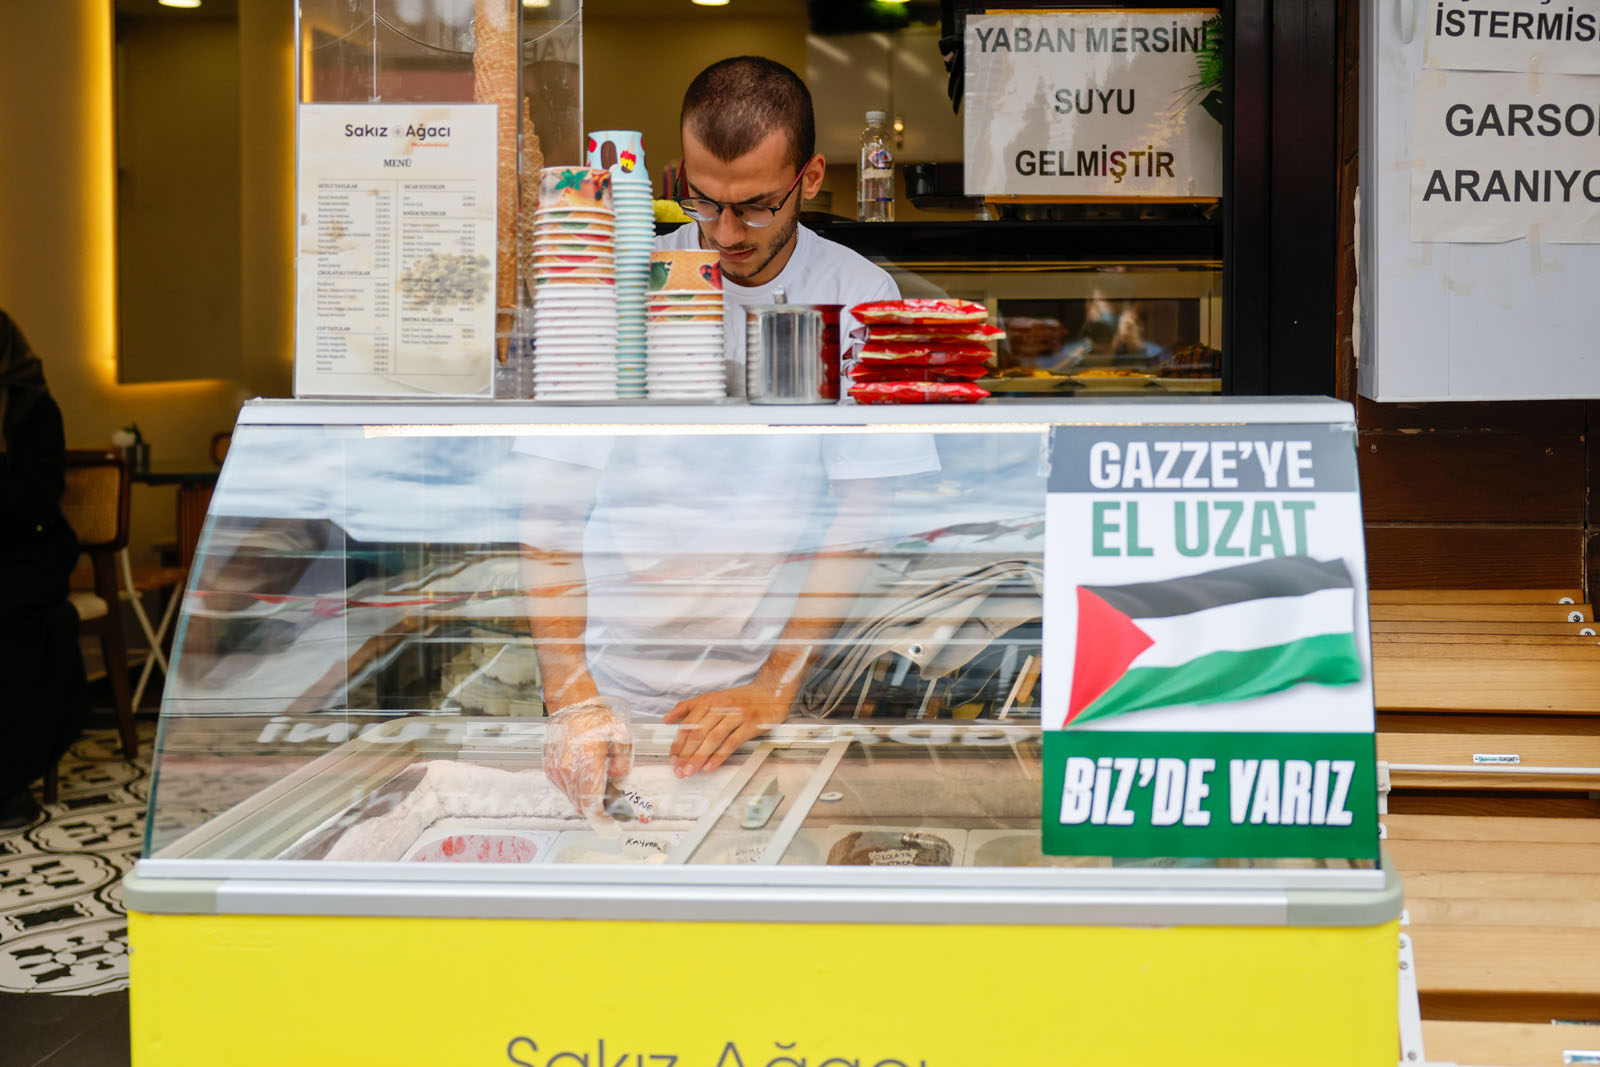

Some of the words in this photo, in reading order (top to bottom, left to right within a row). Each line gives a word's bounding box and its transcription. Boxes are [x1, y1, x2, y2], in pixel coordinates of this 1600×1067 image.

[975, 27, 1077, 53] YABAN
[1435, 2, 1600, 42] İSTERMİS
[1054, 88, 1136, 115] SUYU
[1445, 103, 1600, 137] GARSO
[344, 123, 389, 137] Sakız
[405, 123, 451, 141] Ağacı
[383, 158, 412, 168] MENÜ
[1015, 144, 1176, 184] GELMİŞTİR
[1089, 441, 1315, 489] GAZZE'YE
[1091, 500, 1154, 557] EL
[1173, 500, 1316, 558] UZAT
[1228, 758, 1356, 827] VARIZ
